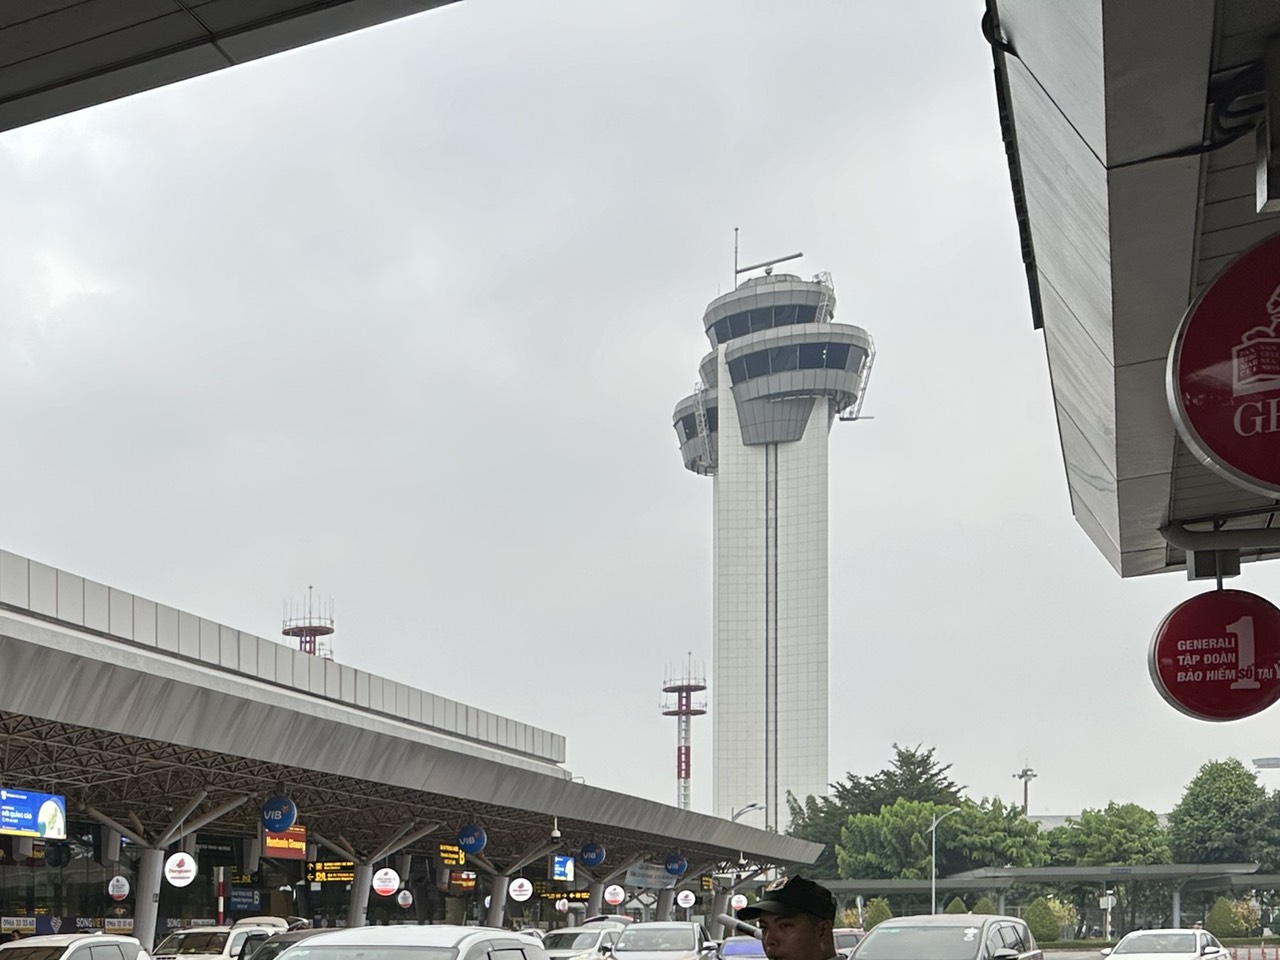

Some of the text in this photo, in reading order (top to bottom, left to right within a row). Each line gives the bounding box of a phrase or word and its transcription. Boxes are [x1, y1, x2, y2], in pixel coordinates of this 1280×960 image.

[1177, 637, 1236, 651] GENERALI
[1177, 651, 1236, 668] TẬP ĐOÀN
[1225, 615, 1261, 690] 1
[1177, 668, 1203, 682] BẢO
[1206, 665, 1236, 681] HIỂM
[1239, 664, 1255, 680] SỐ
[1257, 669, 1273, 682] TẠI
[263, 810, 282, 820] VIB
[459, 836, 475, 845] VIB
